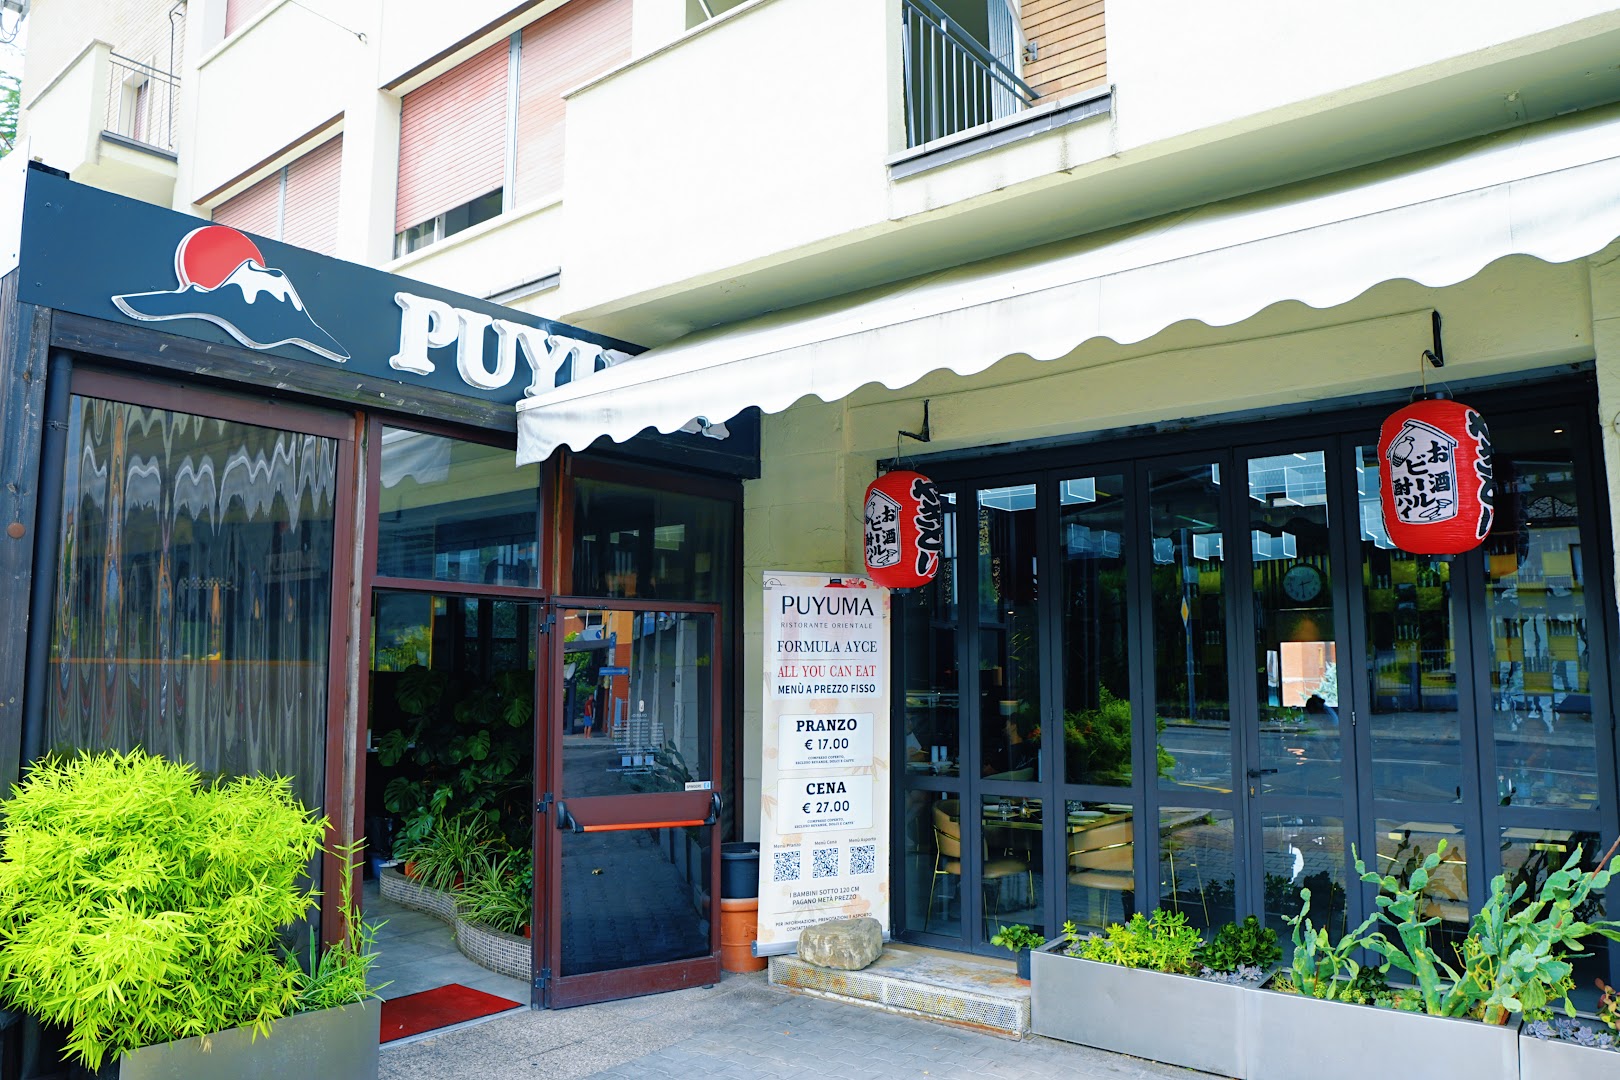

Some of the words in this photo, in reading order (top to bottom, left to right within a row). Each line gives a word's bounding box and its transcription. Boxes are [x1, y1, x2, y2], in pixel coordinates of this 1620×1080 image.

[1428, 440, 1450, 493] お酒
[1406, 454, 1436, 508] ビール
[1392, 476, 1413, 519] 酎ハイ
[882, 505, 896, 545] お酒
[870, 515, 886, 556] ビール
[782, 595, 874, 616] PUYUMA
[777, 640, 841, 653] FORMULA
[844, 640, 878, 653] AYCE
[777, 665, 799, 678] ALL
[802, 665, 827, 678] YOU
[829, 665, 852, 678] CAN
[855, 665, 877, 677] EAT
[778, 682, 804, 694] MENÙ
[806, 684, 812, 694] A
[814, 684, 849, 694] PREZZO
[851, 684, 876, 693] FISSO
[796, 718, 858, 732] PRANZO
[804, 739, 813, 750] €
[818, 738, 849, 750] 17.00
[805, 781, 847, 796] CENA
[802, 802, 811, 814] €
[815, 800, 850, 814] 27.00
[792, 889, 818, 898] BAMBINI
[819, 888, 839, 896] SOTTO
[792, 897, 817, 906] PAGANO
[817, 894, 834, 903] METÀ
[834, 893, 857, 902] PREZZO
